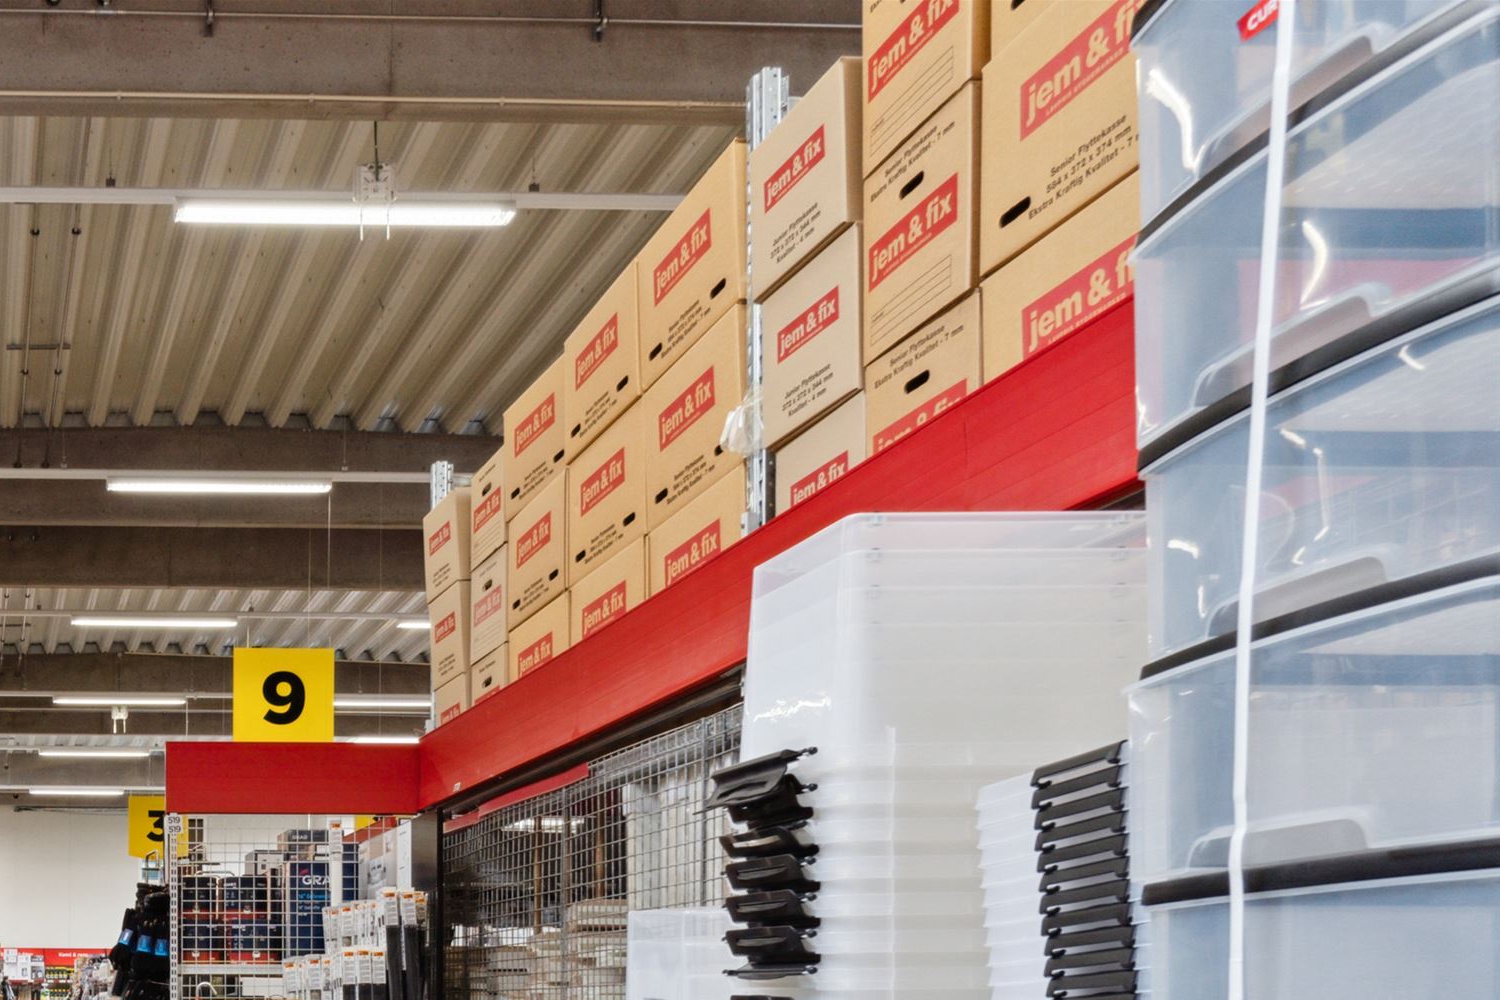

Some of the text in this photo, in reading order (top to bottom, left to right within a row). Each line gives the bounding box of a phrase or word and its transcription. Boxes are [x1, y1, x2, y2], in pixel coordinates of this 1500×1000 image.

[1247, 0, 1278, 30] CUR
[871, 36, 906, 93] jem
[909, 15, 925, 46] &
[927, 0, 954, 27] fix
[1026, 0, 1145, 128] jem & fi
[767, 138, 821, 207] jem & fix
[1050, 114, 1126, 177] Senior Flyttekasse
[1070, 158, 1086, 176] 372
[1096, 138, 1112, 156] 374
[1028, 197, 1054, 220] Ekstra
[1055, 175, 1083, 200] Kraftig
[1085, 148, 1118, 178] Kvalitet
[655, 223, 708, 298] jem & fix
[872, 233, 905, 282] jem
[908, 214, 923, 243] &
[926, 193, 952, 230] fix
[780, 299, 836, 357] jem & fix
[1028, 290, 1083, 353] jem
[1087, 268, 1112, 306] &
[661, 381, 712, 444] jem & fix
[582, 460, 622, 511] jem & fix
[793, 462, 846, 505] jem & fix
[667, 532, 717, 586] jem & fix
[583, 591, 624, 636] jem & fix
[262, 671, 306, 725] 9
[146, 810, 165, 841] 3
[168, 816, 181, 824] 519
[168, 825, 181, 833] 519
[302, 875, 331, 885] GRA
